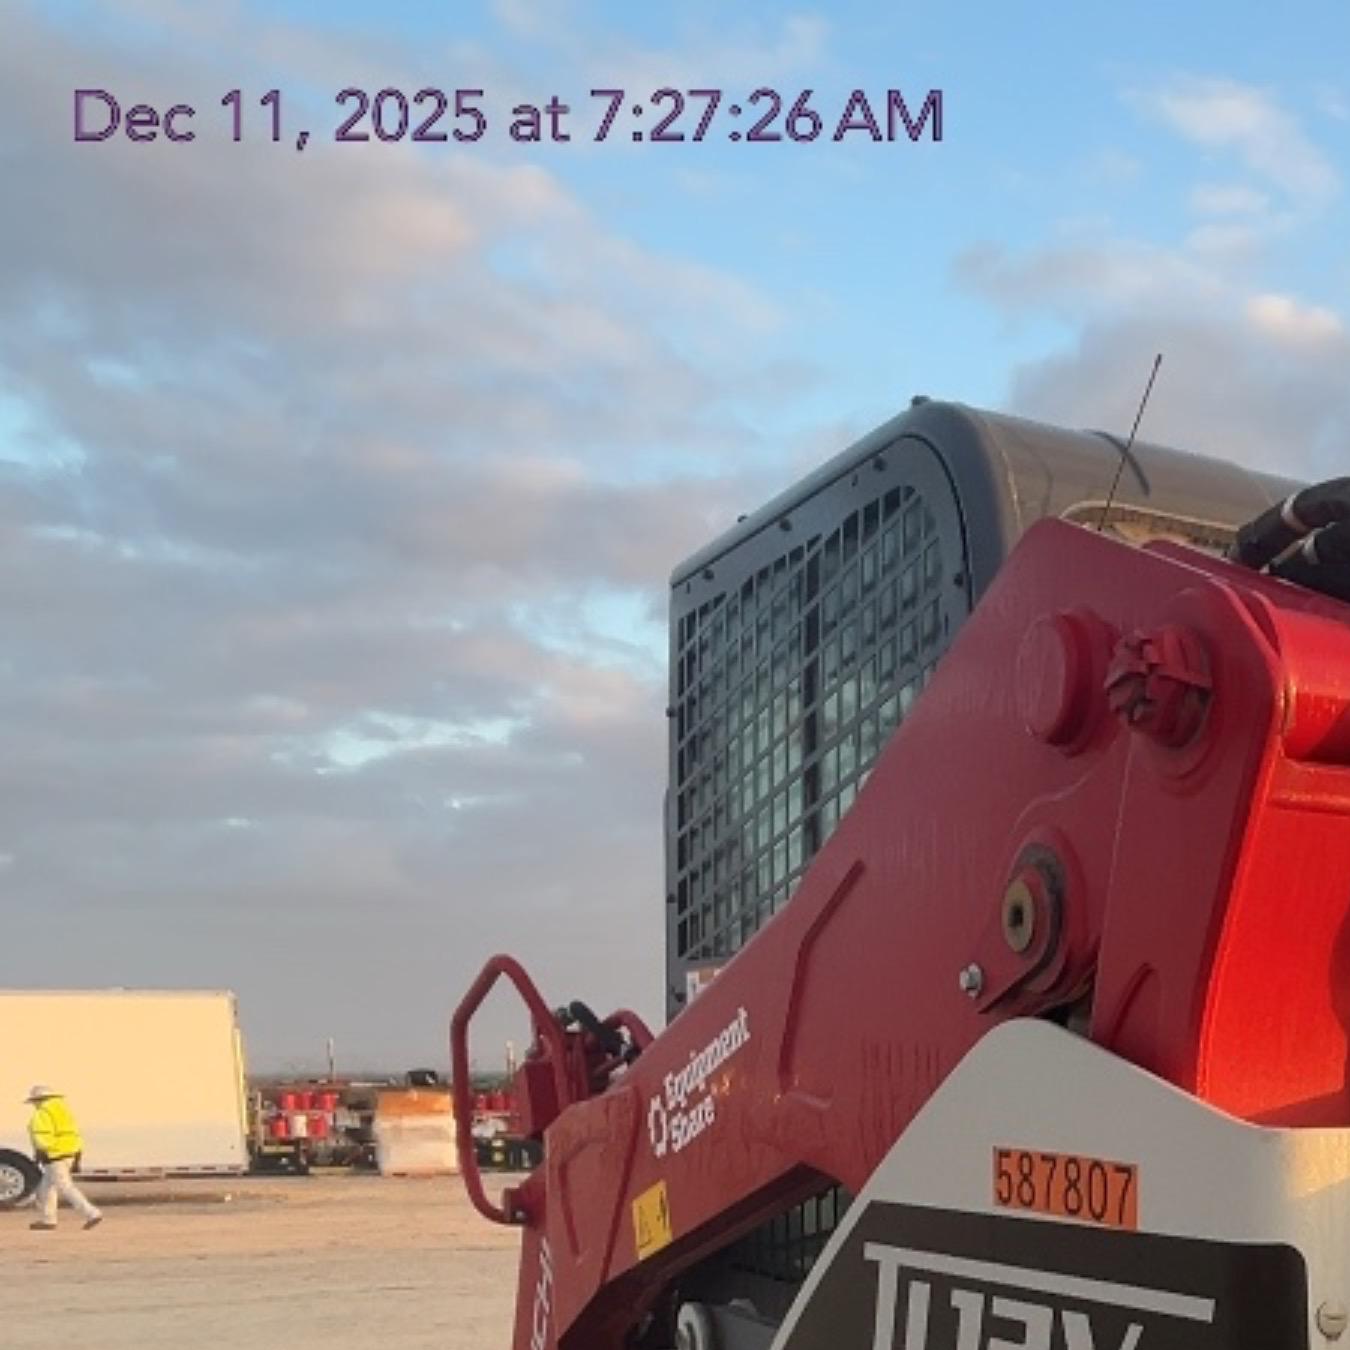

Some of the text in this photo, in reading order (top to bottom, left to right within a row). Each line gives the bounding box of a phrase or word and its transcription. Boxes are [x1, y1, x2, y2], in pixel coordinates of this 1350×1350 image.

[664, 1006, 750, 1110] Equipment
[670, 1095, 715, 1152] Share
[995, 1150, 1132, 1226] 587807
